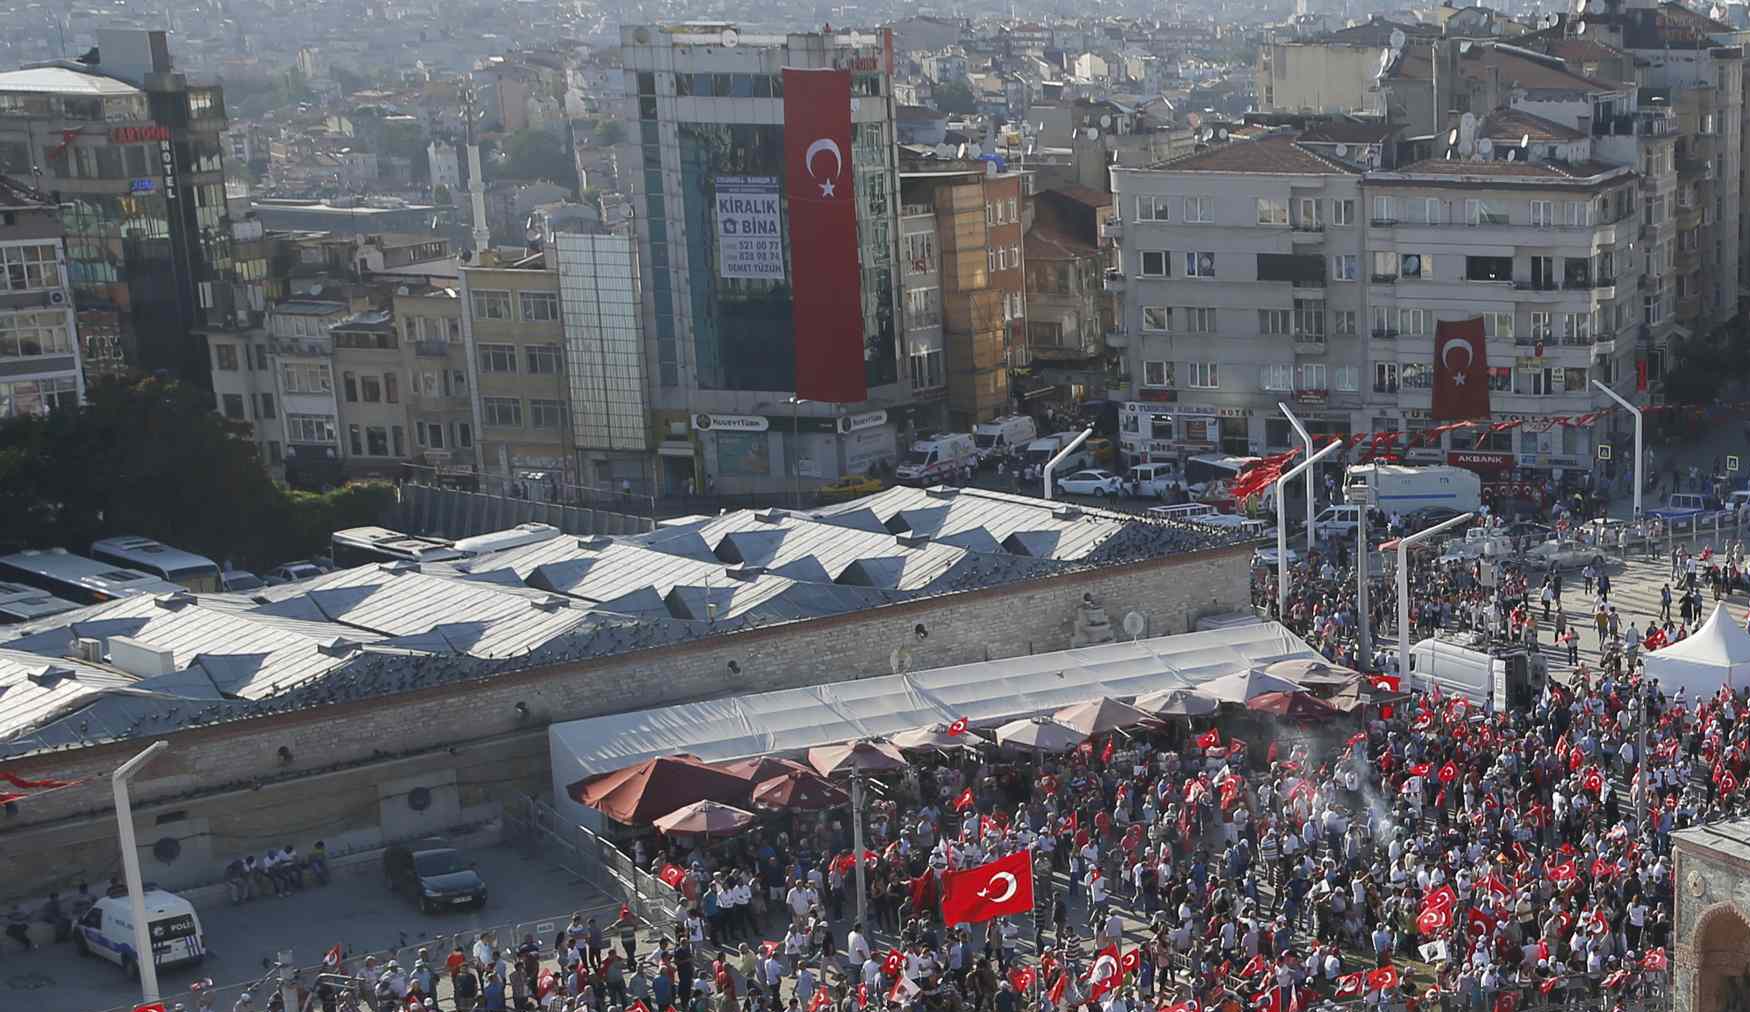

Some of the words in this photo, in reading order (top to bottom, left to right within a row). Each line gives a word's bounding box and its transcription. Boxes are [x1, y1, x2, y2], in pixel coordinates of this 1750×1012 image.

[161, 140, 176, 199] HOTEL
[719, 196, 777, 214] KİRALIK
[742, 216, 777, 234] BİNA
[1458, 455, 1503, 464] AKBANK
